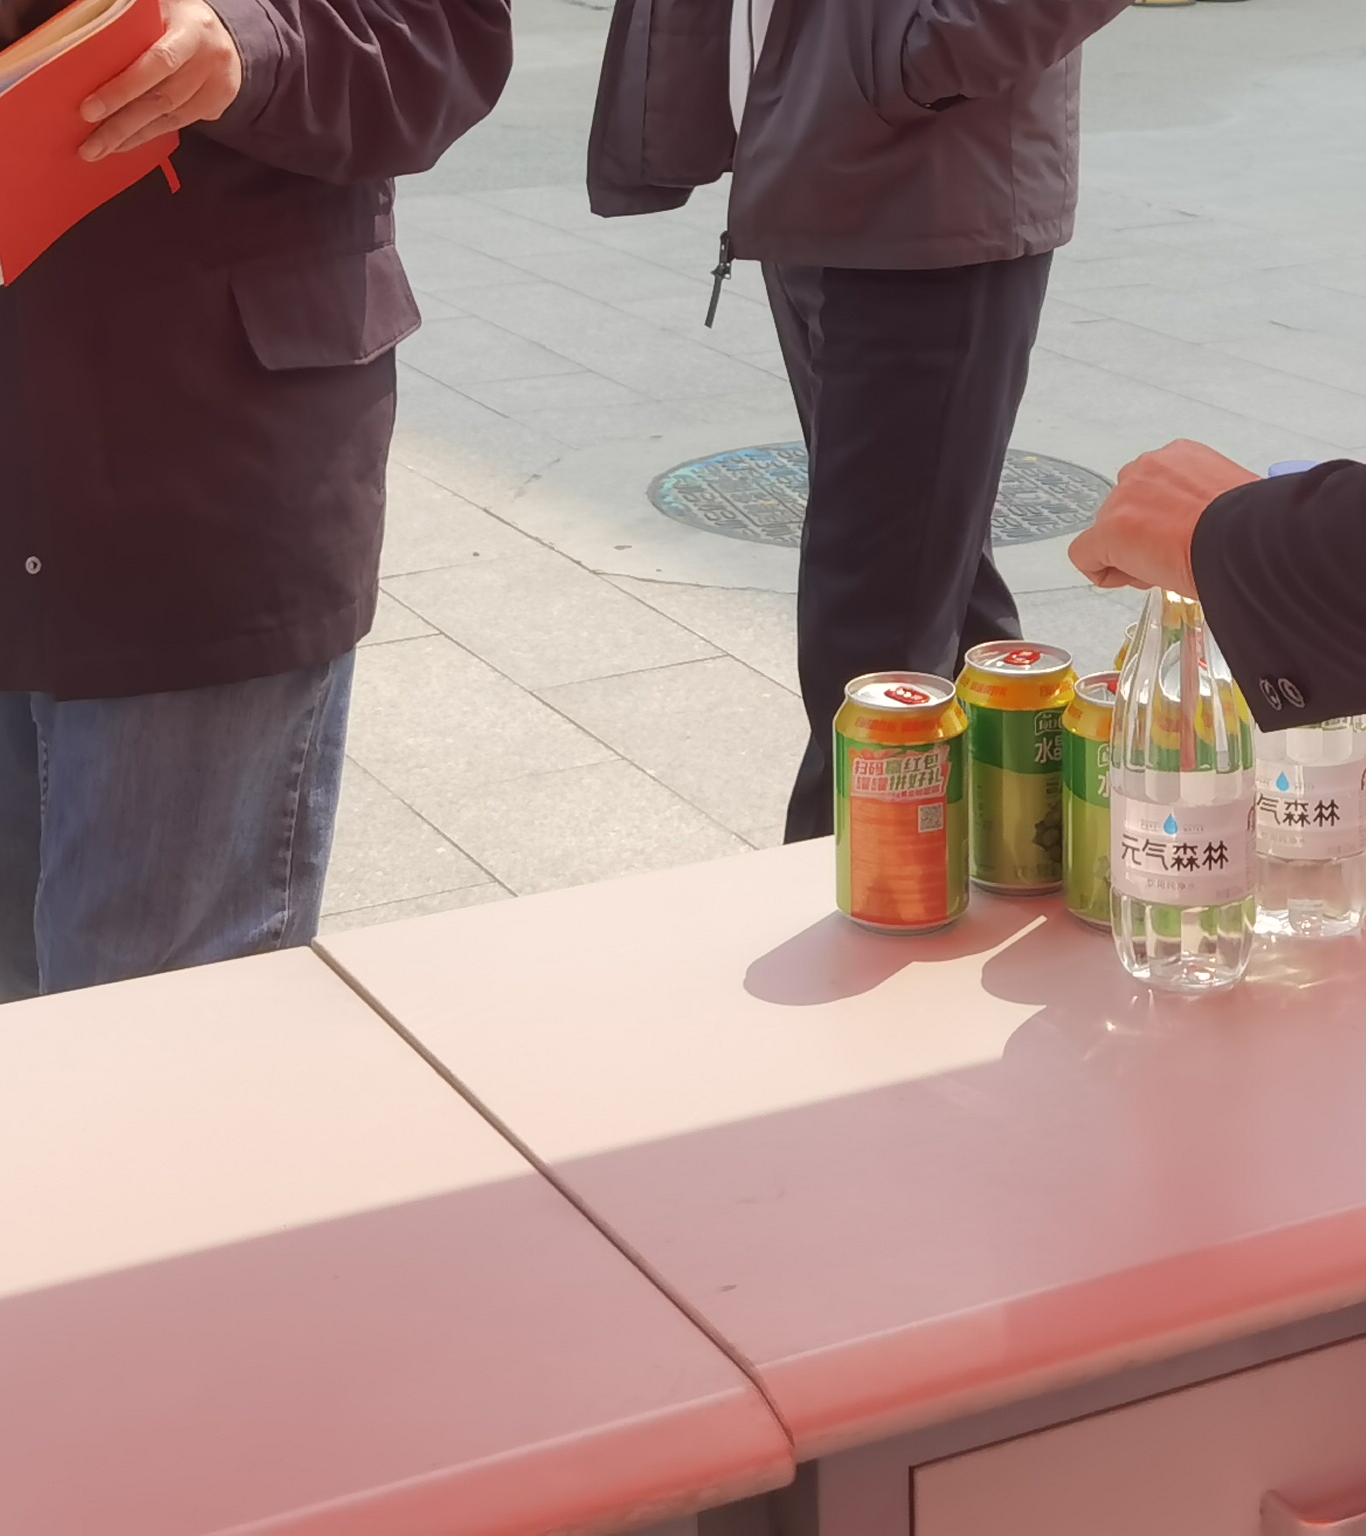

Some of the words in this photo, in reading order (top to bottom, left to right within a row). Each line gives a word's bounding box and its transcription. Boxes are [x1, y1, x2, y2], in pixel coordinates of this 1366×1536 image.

[1256, 792, 1341, 828] 气森林
[1121, 832, 1230, 872] 元气森林
